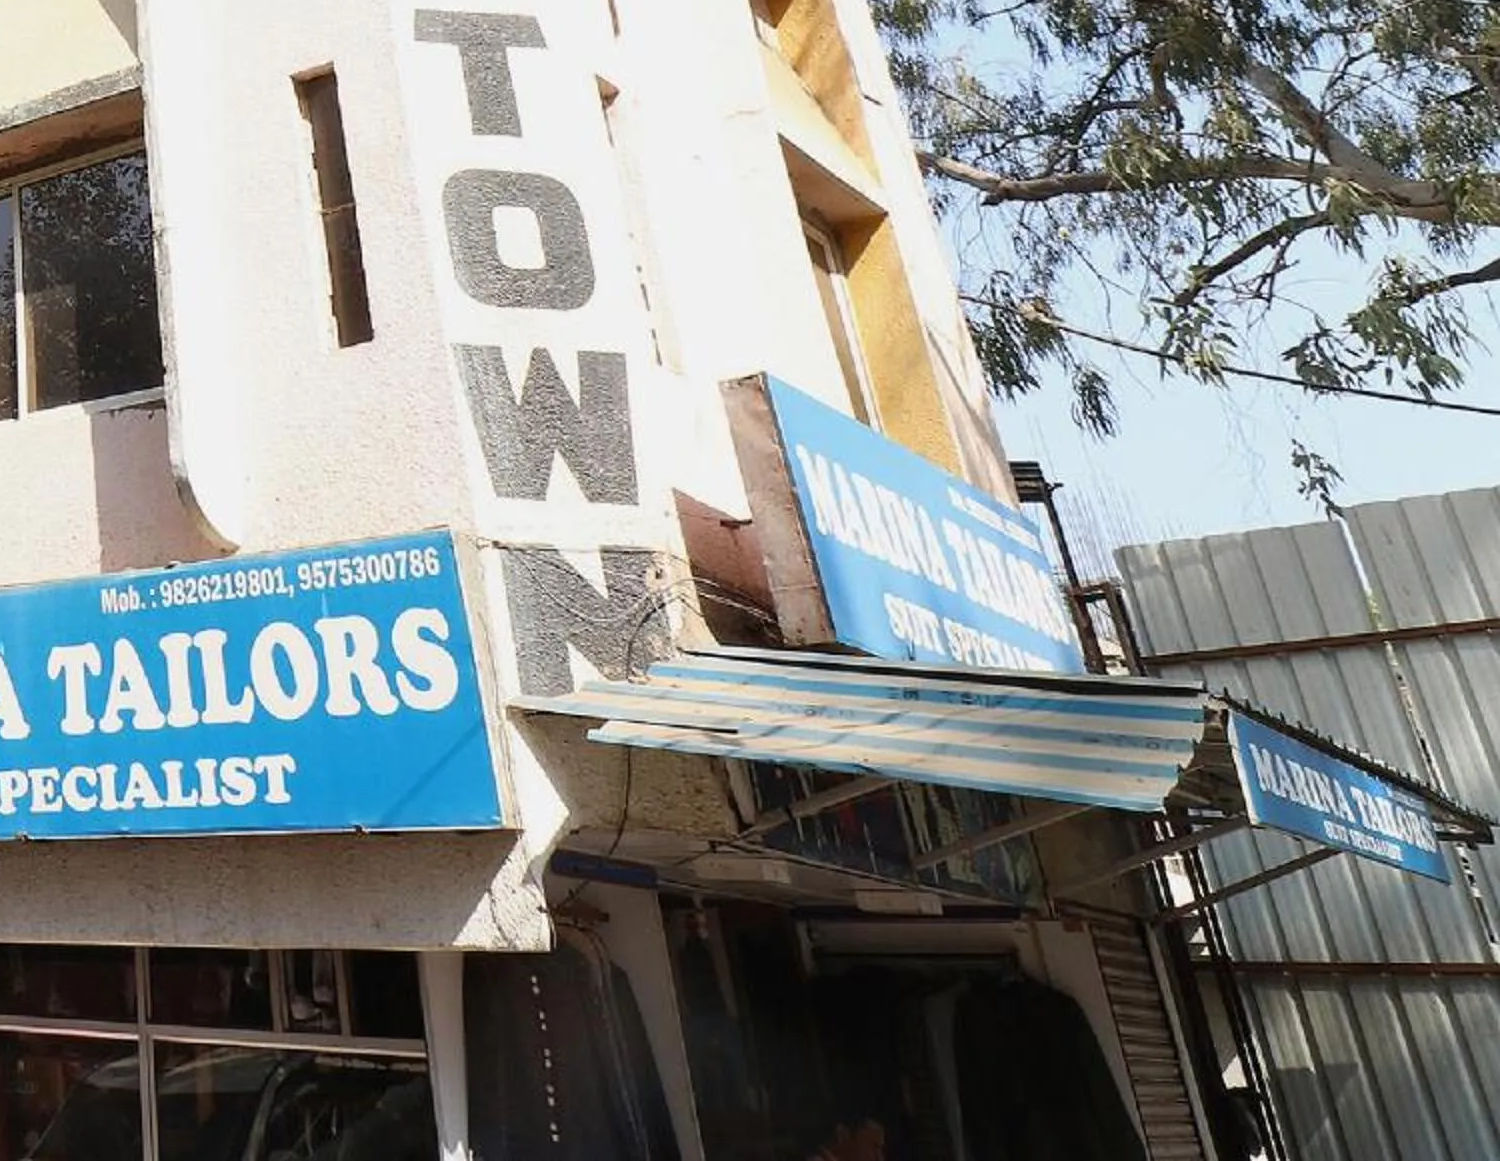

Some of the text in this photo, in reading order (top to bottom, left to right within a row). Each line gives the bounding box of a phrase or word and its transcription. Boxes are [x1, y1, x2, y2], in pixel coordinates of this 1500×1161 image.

[159, 571, 295, 608] 9826219801,
[297, 547, 441, 590] 9575300786
[795, 444, 958, 594] MARINA
[940, 517, 1072, 645] TAILORS
[47, 607, 460, 739] TAILORS
[884, 593, 946, 656] SUIT
[1249, 743, 1437, 853] MARINA TAILORS
